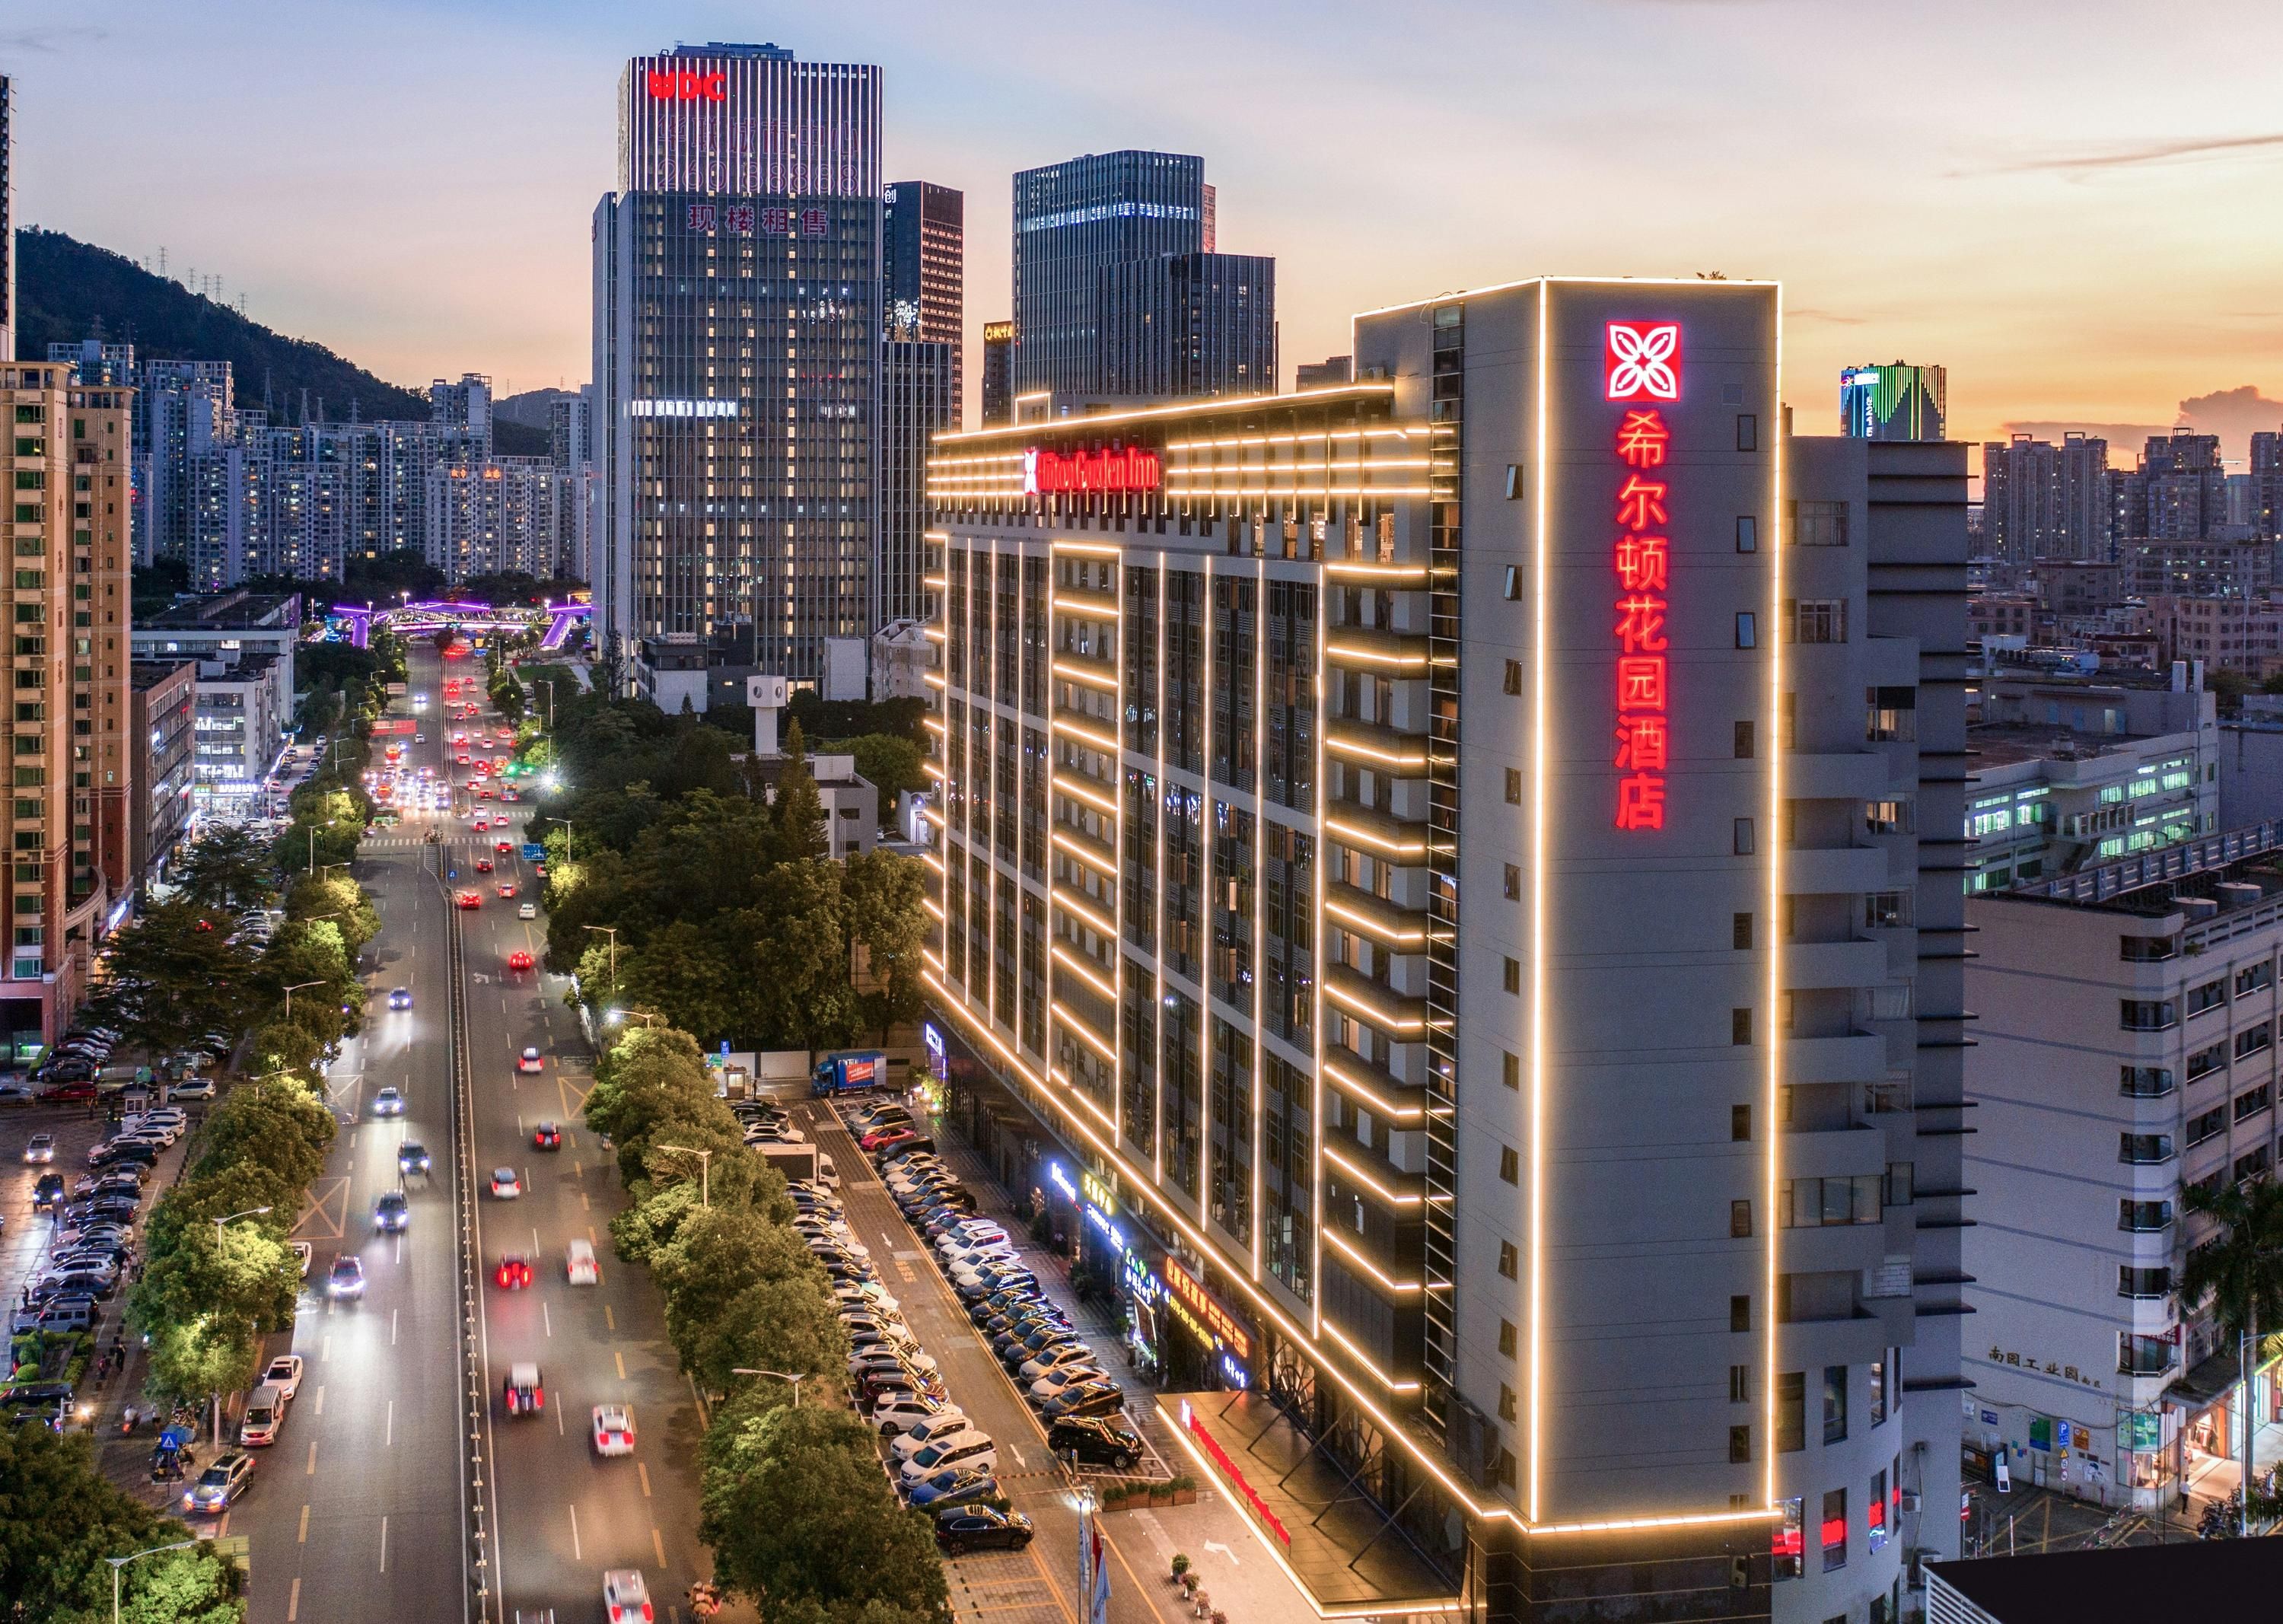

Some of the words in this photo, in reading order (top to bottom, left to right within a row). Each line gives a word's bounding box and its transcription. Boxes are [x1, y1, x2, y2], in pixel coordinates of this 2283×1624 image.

[658, 114, 858, 158] 华联城市中心
[741, 161, 859, 193] 88888
[688, 205, 828, 236] 现楼租售
[1127, 447, 1159, 486] Inn
[1614, 409, 1669, 830] 希尔顿花园酒店
[2061, 1424, 2067, 1434] P
